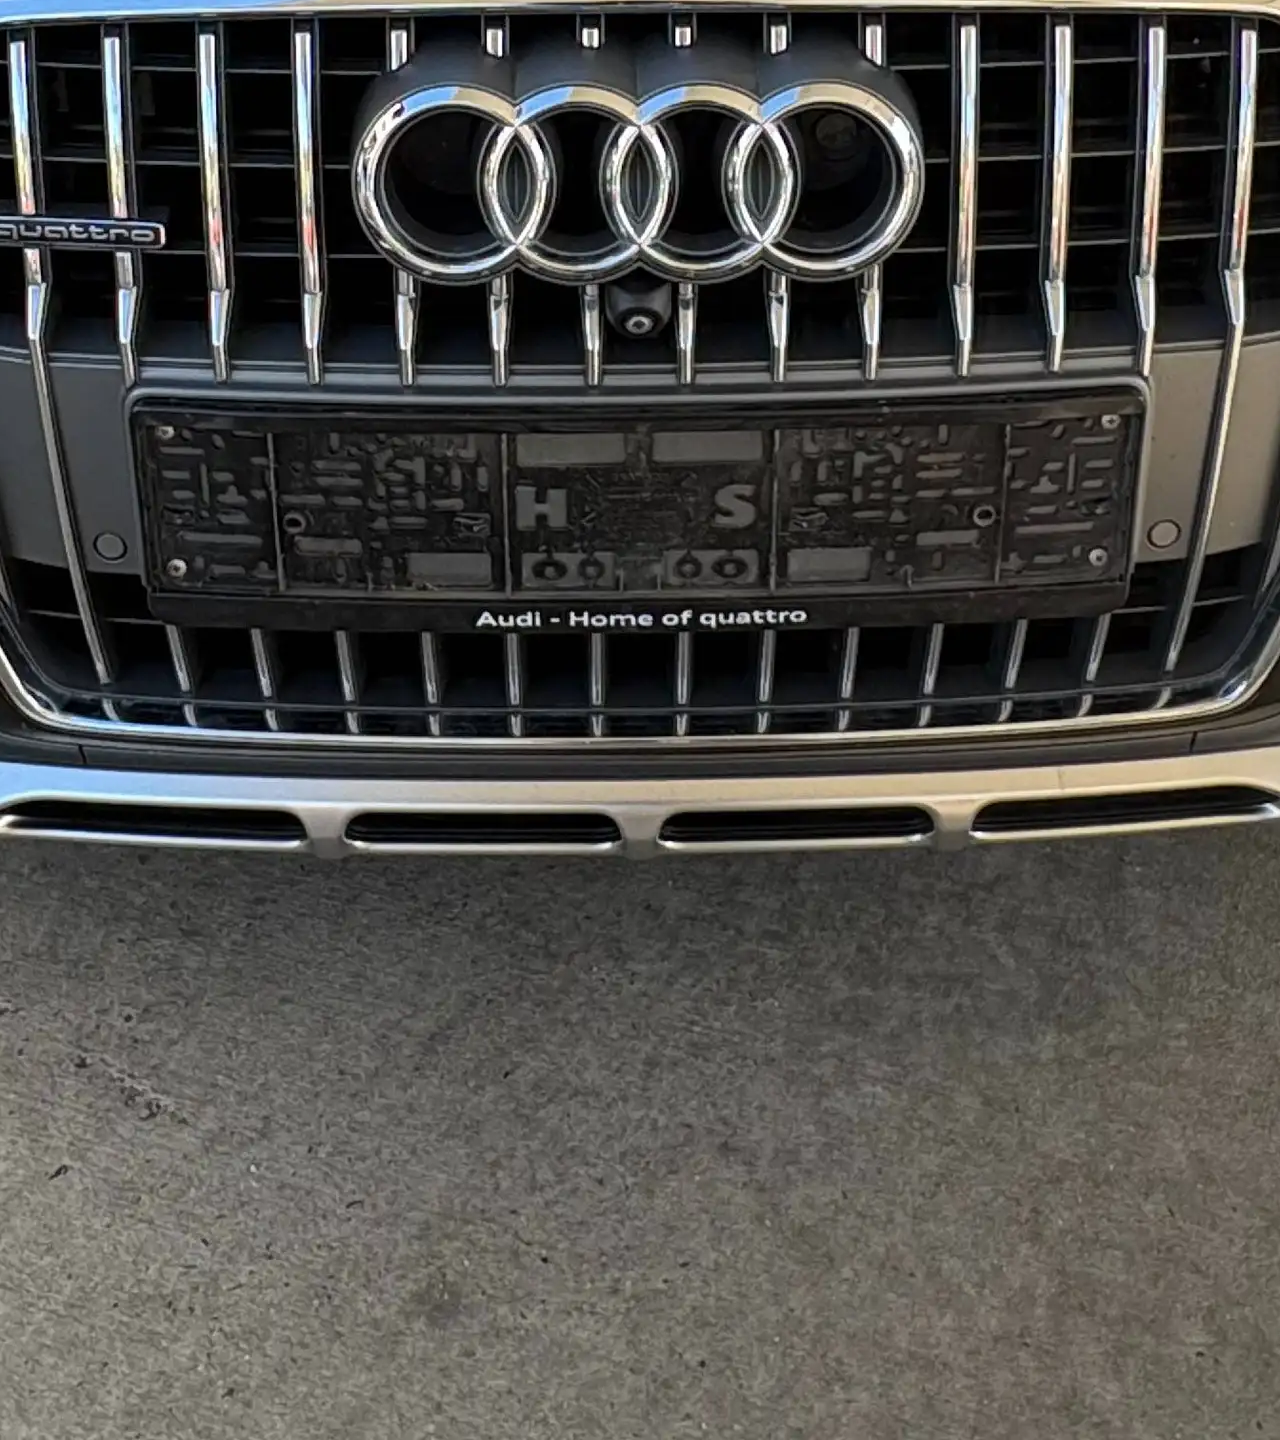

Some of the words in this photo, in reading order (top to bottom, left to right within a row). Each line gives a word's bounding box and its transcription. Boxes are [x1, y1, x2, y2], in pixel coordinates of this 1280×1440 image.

[475, 610, 542, 628] Audi
[569, 610, 654, 628] Home
[661, 608, 694, 627] of
[699, 608, 809, 630] quattro
